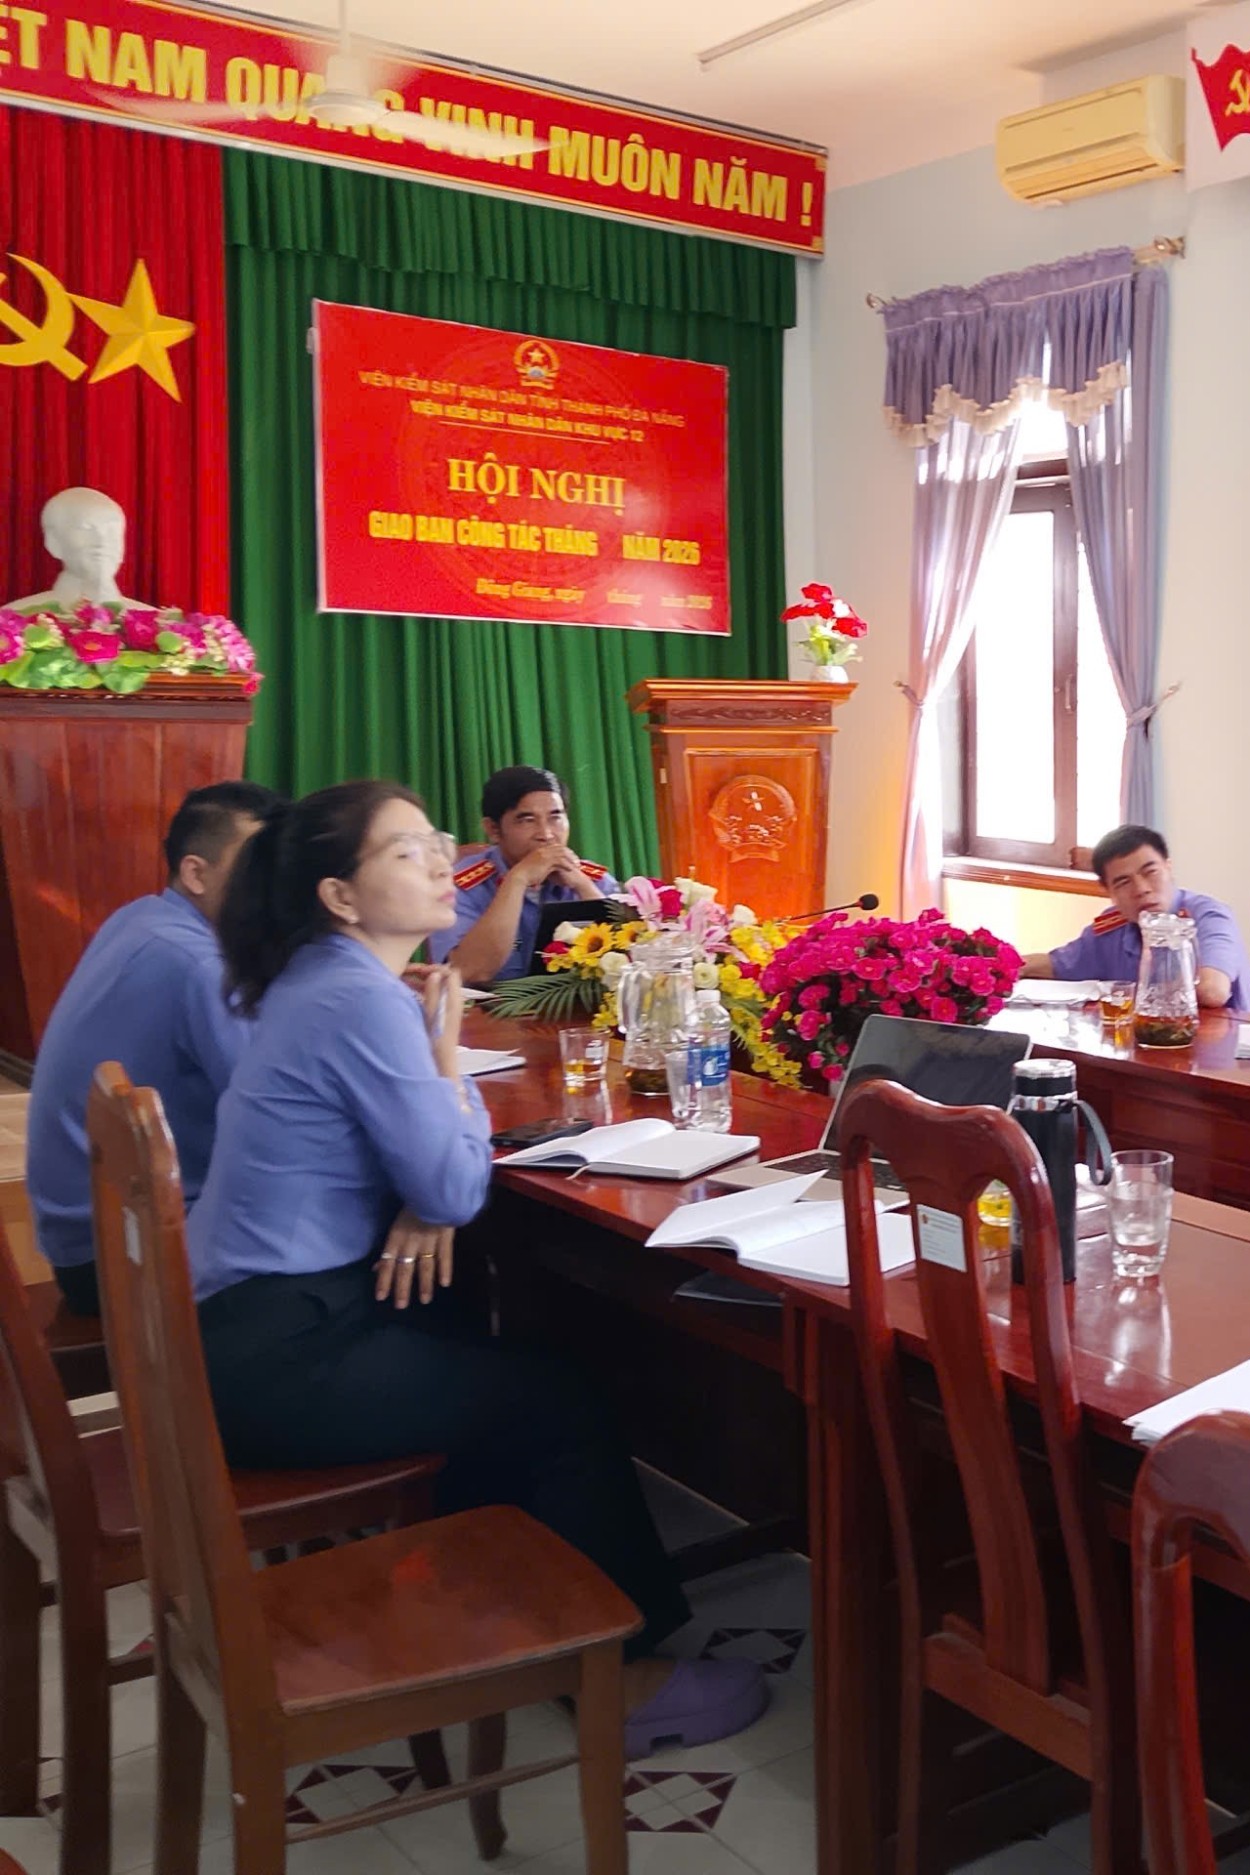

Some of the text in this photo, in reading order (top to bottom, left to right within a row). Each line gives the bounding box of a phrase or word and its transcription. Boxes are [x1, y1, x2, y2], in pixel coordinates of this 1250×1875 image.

[66, 19, 206, 104] NAM
[548, 133, 680, 200] MUÔN
[693, 156, 787, 221] NĂM
[447, 452, 626, 516] HỘI NGHỊ
[368, 510, 413, 541] GIAO
[415, 514, 455, 544] BAN
[456, 515, 506, 549] CÔNG
[508, 519, 541, 552] TÁC
[542, 524, 598, 557] THÁNG
[622, 530, 661, 562] NĂM
